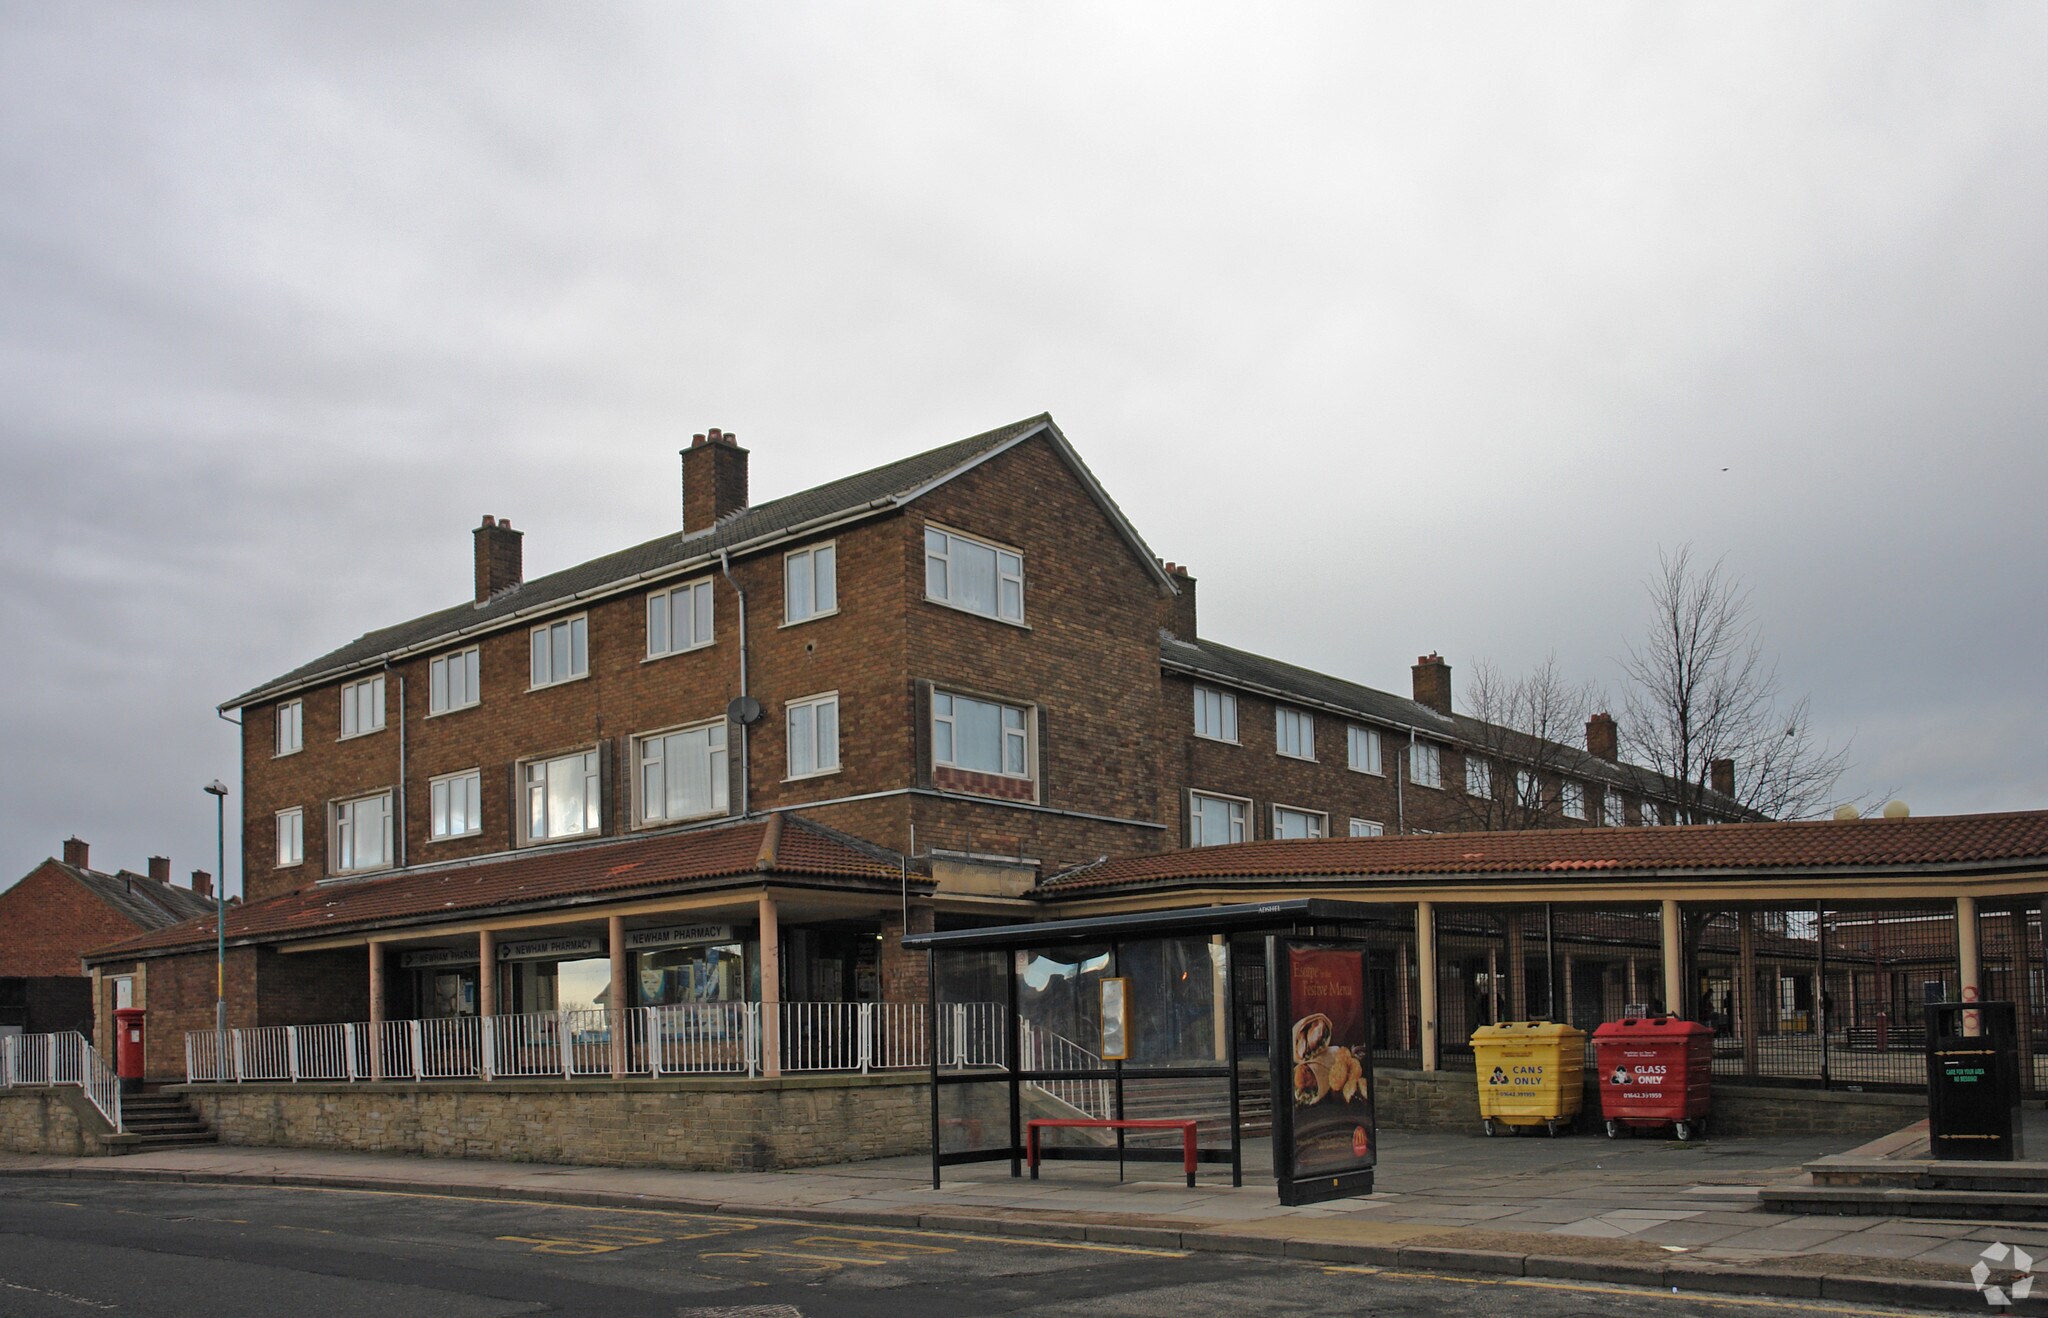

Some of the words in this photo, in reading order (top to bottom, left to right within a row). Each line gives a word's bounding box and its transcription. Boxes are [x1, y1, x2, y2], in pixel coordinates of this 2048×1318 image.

[632, 931, 670, 944] NEWHAM
[673, 926, 722, 940] PHARMACY
[515, 943, 548, 955] NEWHAM
[551, 939, 592, 952] PHARMACY
[1293, 961, 1318, 980] Escape
[1329, 981, 1352, 996] Menu
[1512, 1066, 1543, 1074] CANS
[1634, 1065, 1667, 1074] GLASS
[1514, 1077, 1542, 1085] ONLY
[1638, 1076, 1663, 1084] ONLY
